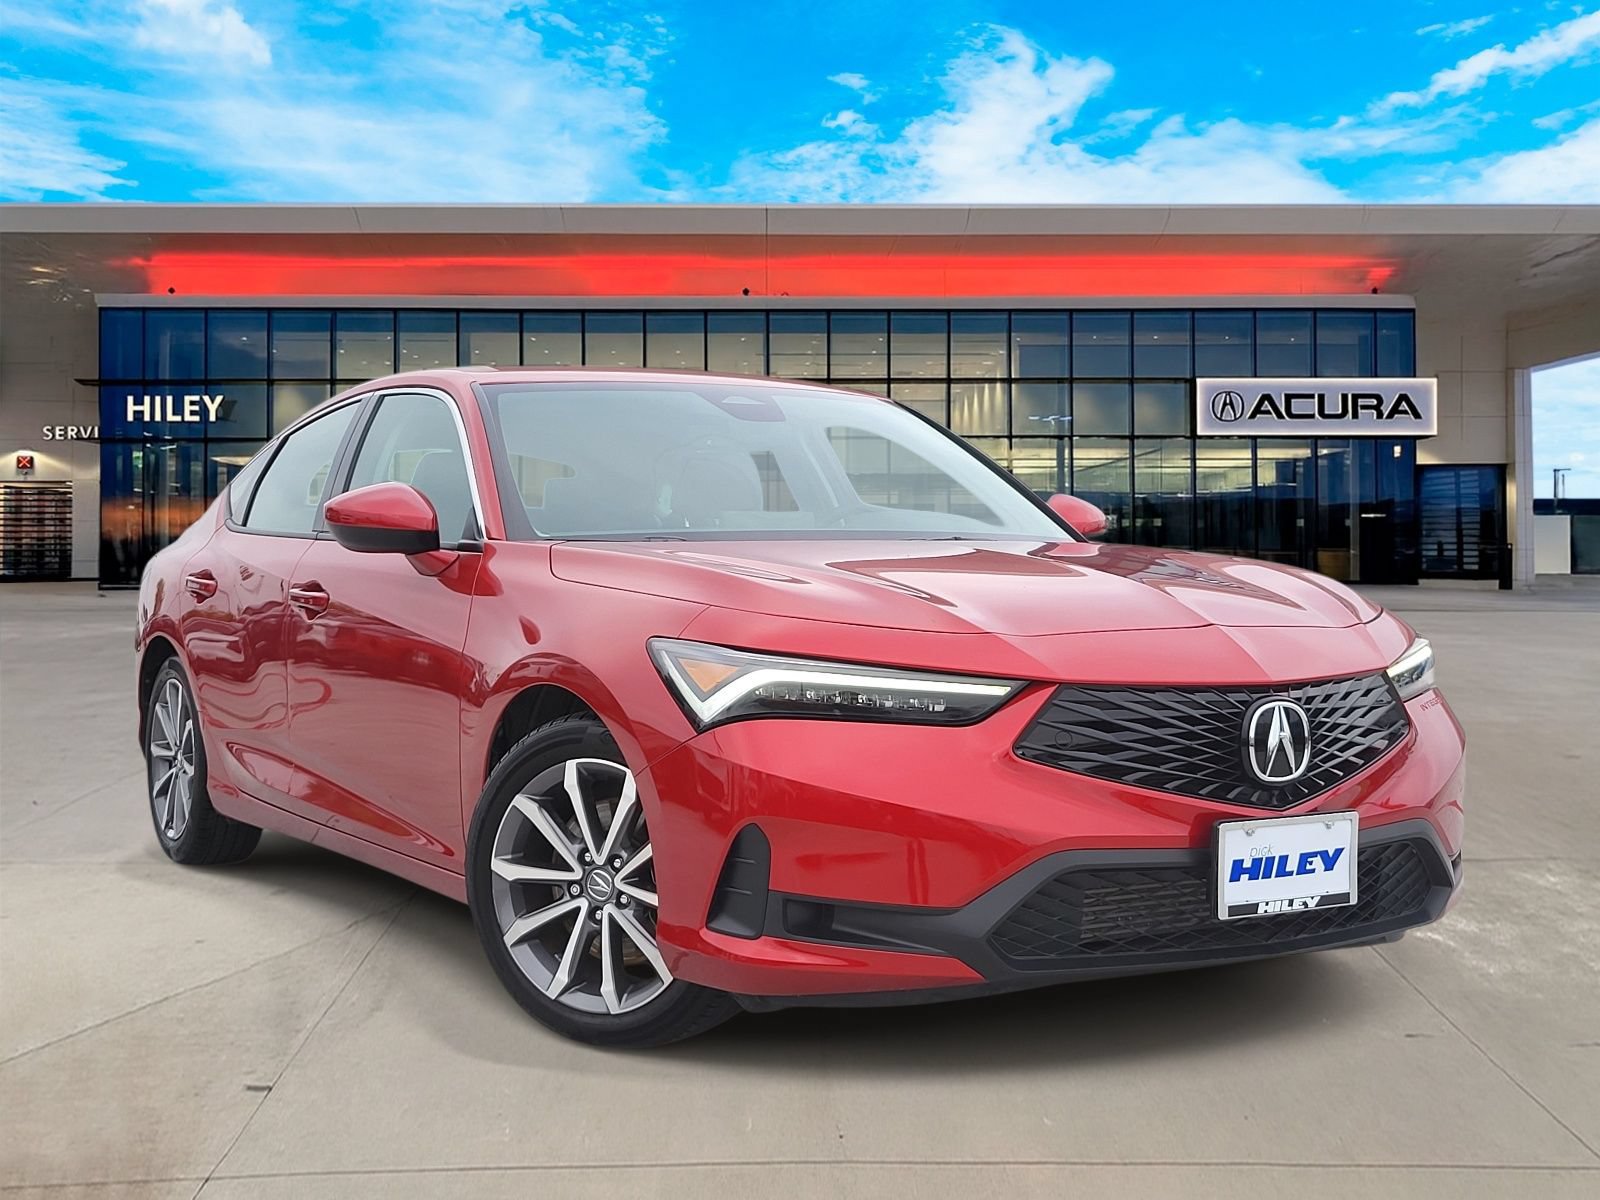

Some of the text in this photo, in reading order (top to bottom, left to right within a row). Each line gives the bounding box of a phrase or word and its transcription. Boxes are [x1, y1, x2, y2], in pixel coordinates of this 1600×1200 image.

[126, 395, 224, 422] HILEY
[1247, 393, 1422, 420] ACURA
[1228, 847, 1345, 883] HILEY
[1257, 896, 1321, 914] HILEY
